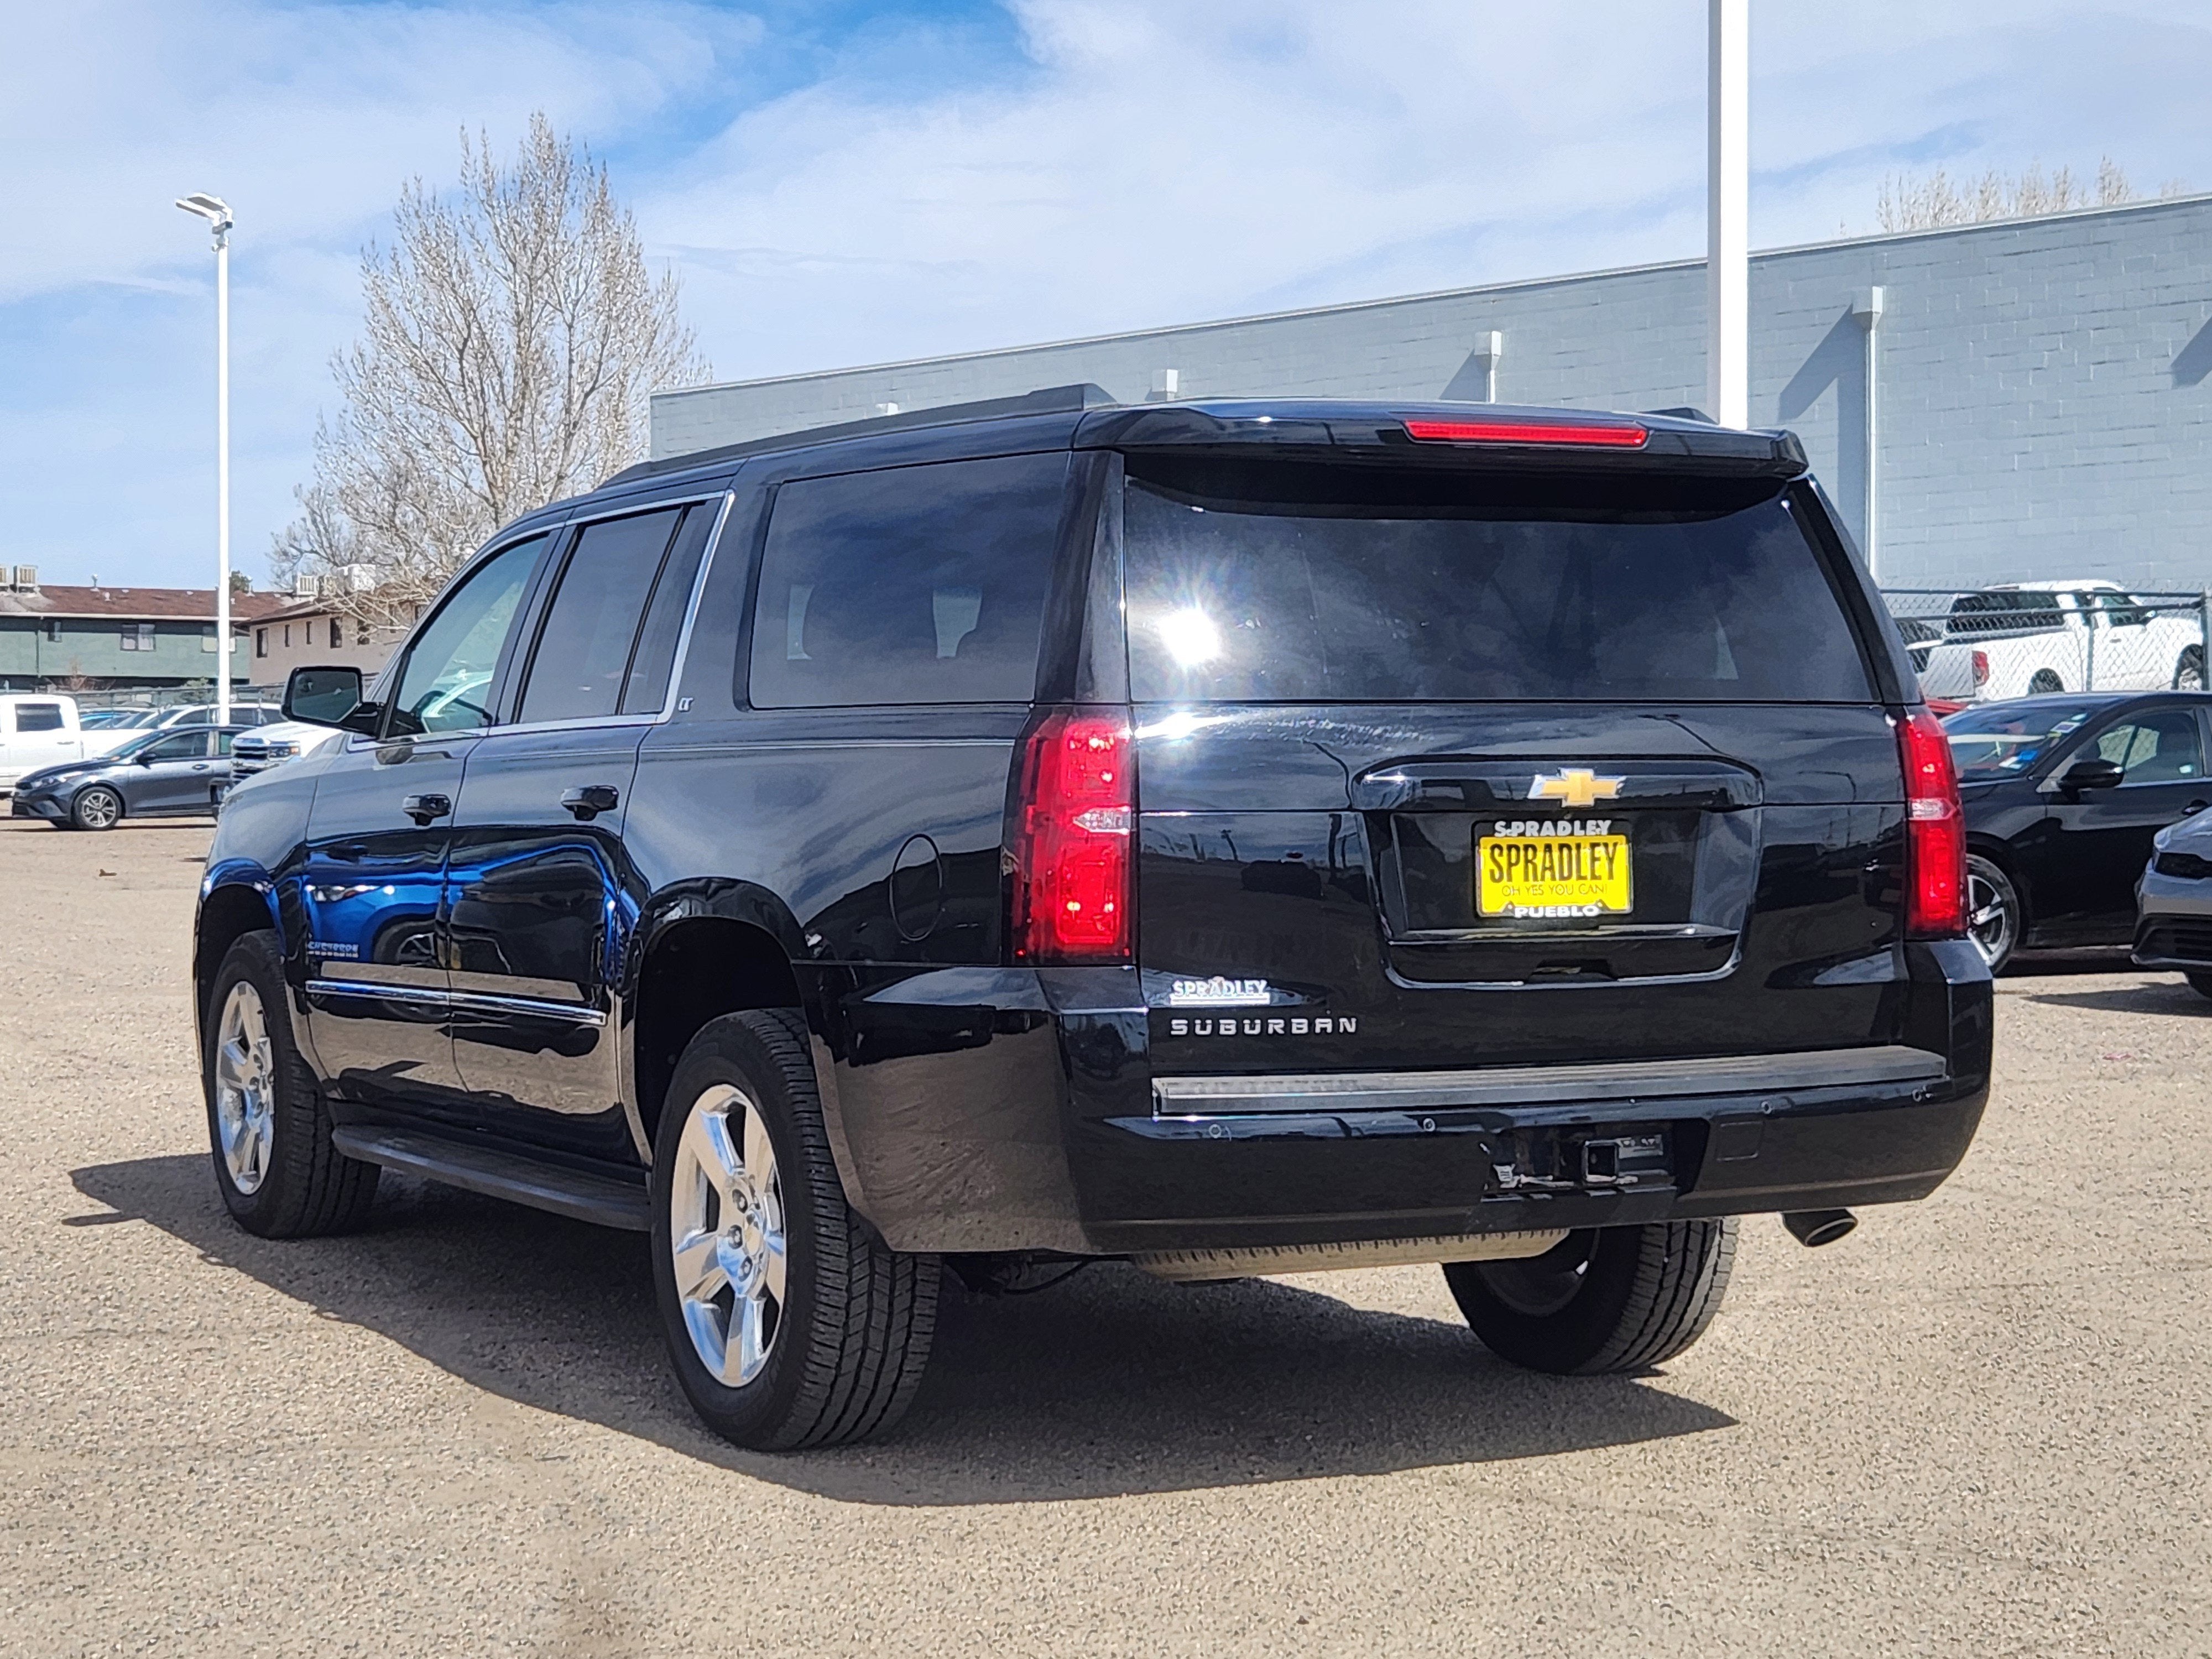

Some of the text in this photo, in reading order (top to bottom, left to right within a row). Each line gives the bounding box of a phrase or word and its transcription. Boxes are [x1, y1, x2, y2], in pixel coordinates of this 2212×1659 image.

[1494, 820, 1611, 837] SPRADLEY
[1489, 842, 1619, 883] SPRADLEY
[1502, 885, 1521, 896] OH
[1526, 884, 1544, 896] YES
[1548, 884, 1574, 895] YOU
[1515, 905, 1599, 918] PUEBLO
[1172, 979, 1267, 996] SPRADLEY
[1171, 1018, 1357, 1035] SUBURBAN
